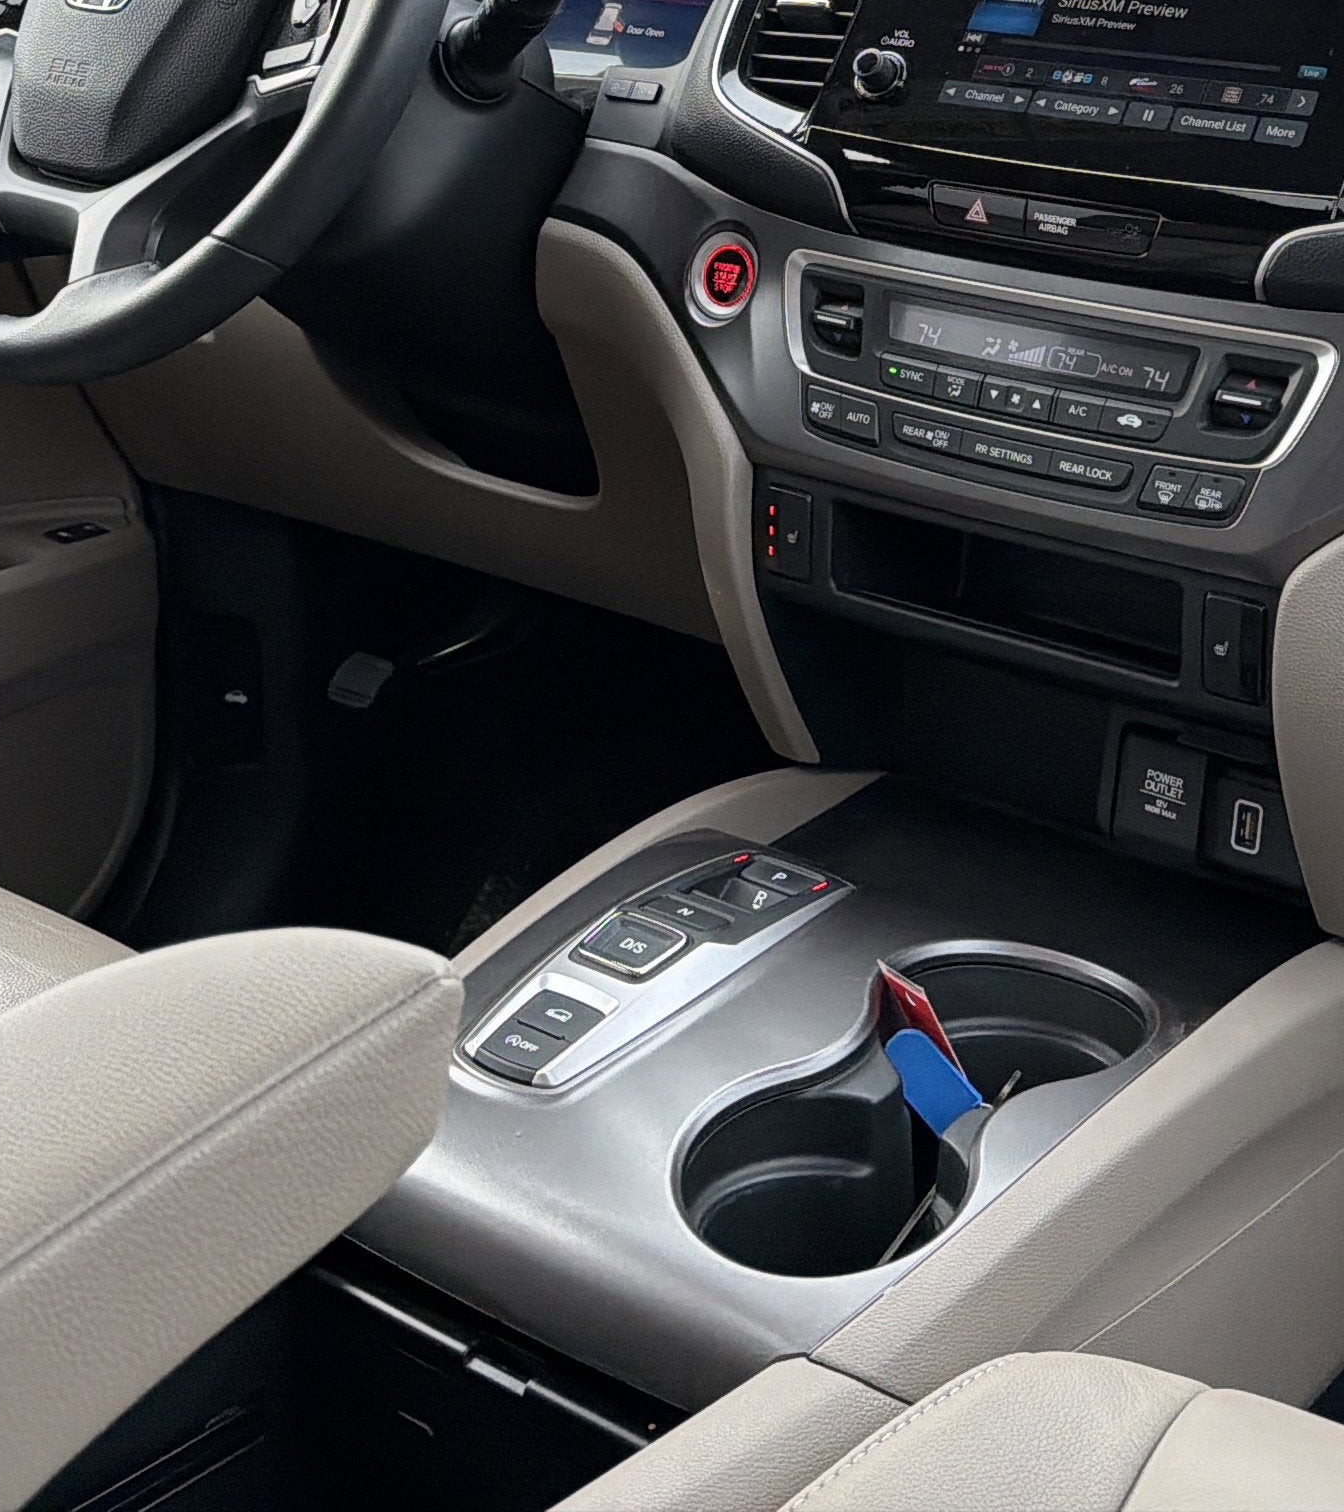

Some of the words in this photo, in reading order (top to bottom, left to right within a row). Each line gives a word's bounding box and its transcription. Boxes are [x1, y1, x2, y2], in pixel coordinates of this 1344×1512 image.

[1127, 0, 1188, 20] Preview
[1051, 13, 1095, 27] SiriusXM
[1096, 18, 1137, 32] Preview
[626, 24, 644, 36] Door
[645, 26, 665, 38] Open
[888, 37, 915, 48] AUDIO
[1025, 67, 1034, 78] 2
[1100, 75, 1109, 86] 8
[1169, 83, 1184, 95] 26
[1259, 93, 1275, 105] 74
[964, 89, 1006, 103] Channel
[1054, 100, 1100, 117] Category
[1180, 115, 1225, 130] Channel
[1226, 121, 1247, 133] List
[1266, 125, 1296, 138] More
[1033, 212, 1077, 227] PASSENGER
[1038, 223, 1069, 236] AIRBAG
[917, 323, 943, 347] 74
[1056, 352, 1077, 371] 74
[899, 369, 925, 383] SYNC
[1142, 365, 1171, 392] 74
[818, 410, 834, 420] OFF
[1068, 404, 1088, 417] A/C
[846, 411, 871, 425] AUTO
[902, 425, 926, 438] REAR
[932, 438, 949, 449] OFF
[975, 443, 989, 455] RR
[989, 447, 1033, 465] SETTINGS
[1059, 460, 1086, 474] REAR
[1086, 466, 1113, 481] LOCK
[1154, 480, 1182, 493] FRONT
[1200, 487, 1223, 499] REAR
[1146, 768, 1184, 789] POWER
[1145, 779, 1184, 800] OUTLET
[1161, 808, 1177, 819] MAX
[772, 871, 787, 882] P
[755, 889, 768, 903] R
[677, 907, 694, 917] N
[618, 937, 648, 954] D/S
[518, 1040, 539, 1053] OFF
